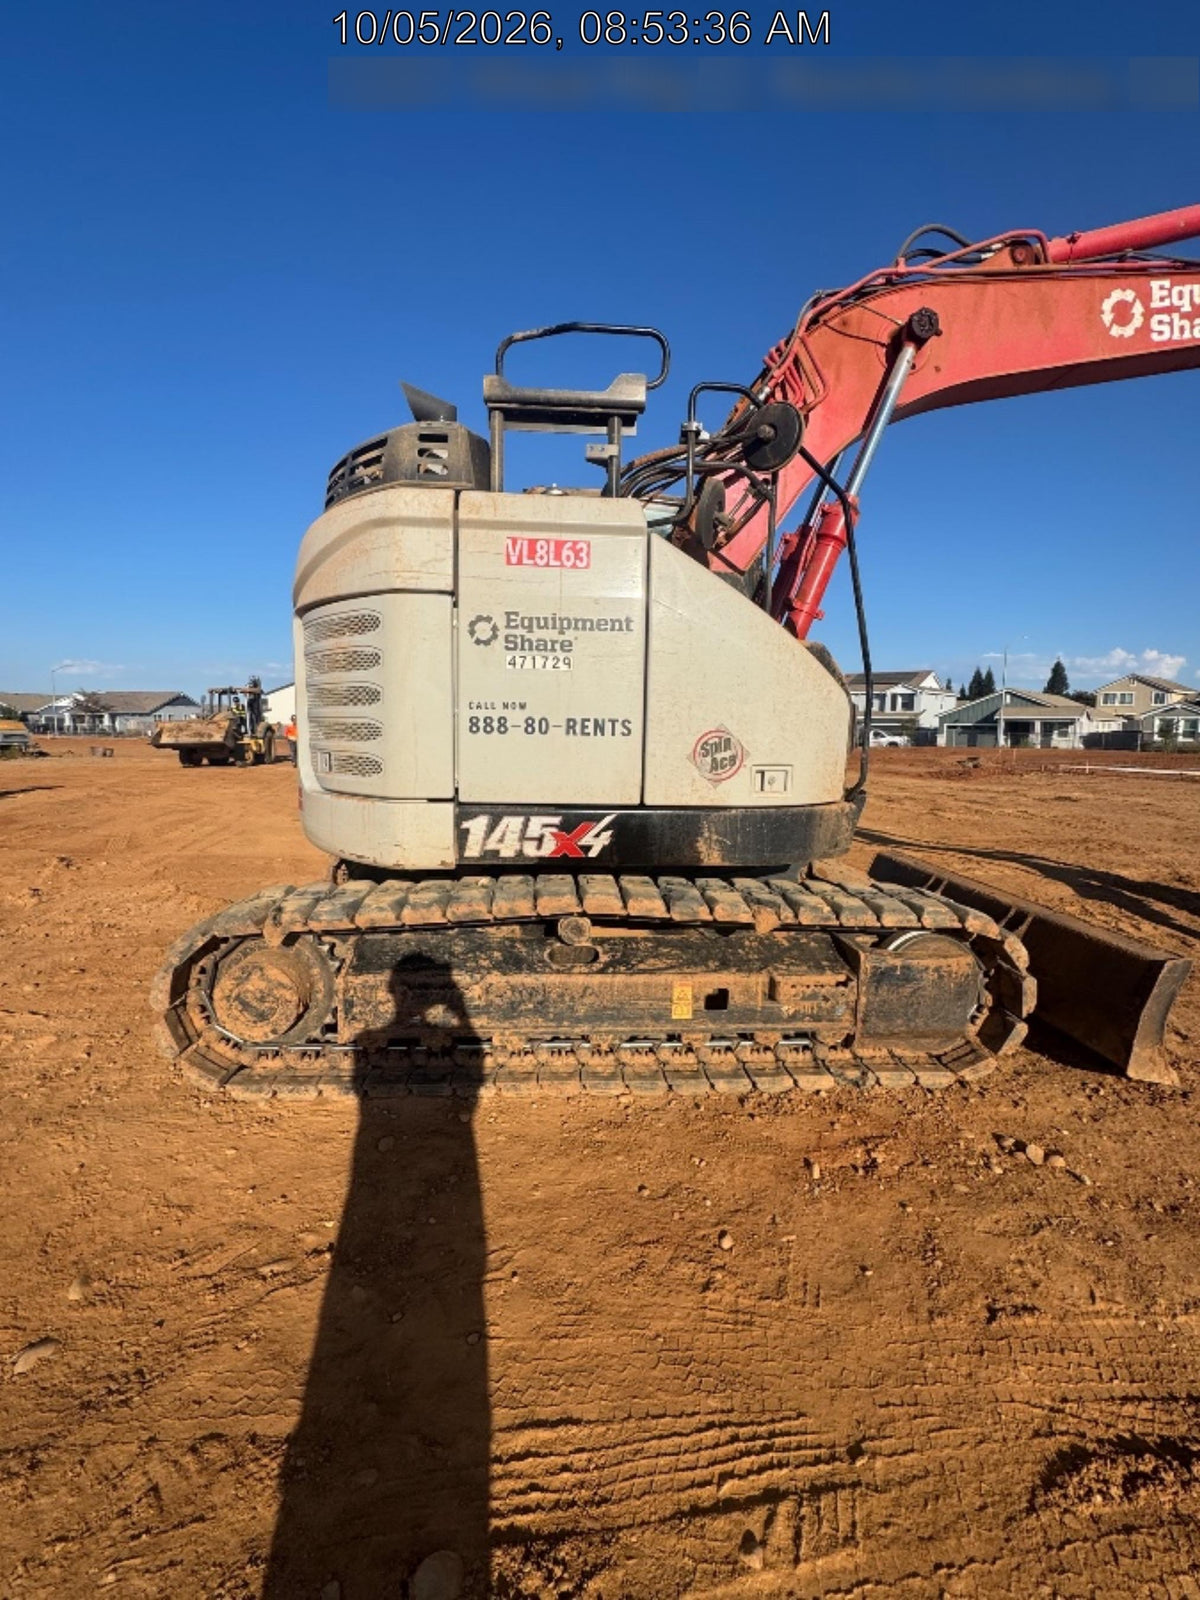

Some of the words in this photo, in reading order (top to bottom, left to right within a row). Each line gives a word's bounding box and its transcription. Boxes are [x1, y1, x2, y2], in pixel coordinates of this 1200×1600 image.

[506, 538, 589, 568] VL8L63
[504, 611, 634, 635] Equipment
[504, 634, 574, 653] Share
[507, 655, 572, 669] 471729
[468, 701, 496, 710] CALL
[502, 702, 527, 711] NOW
[468, 716, 633, 737] 888-80-RENTS
